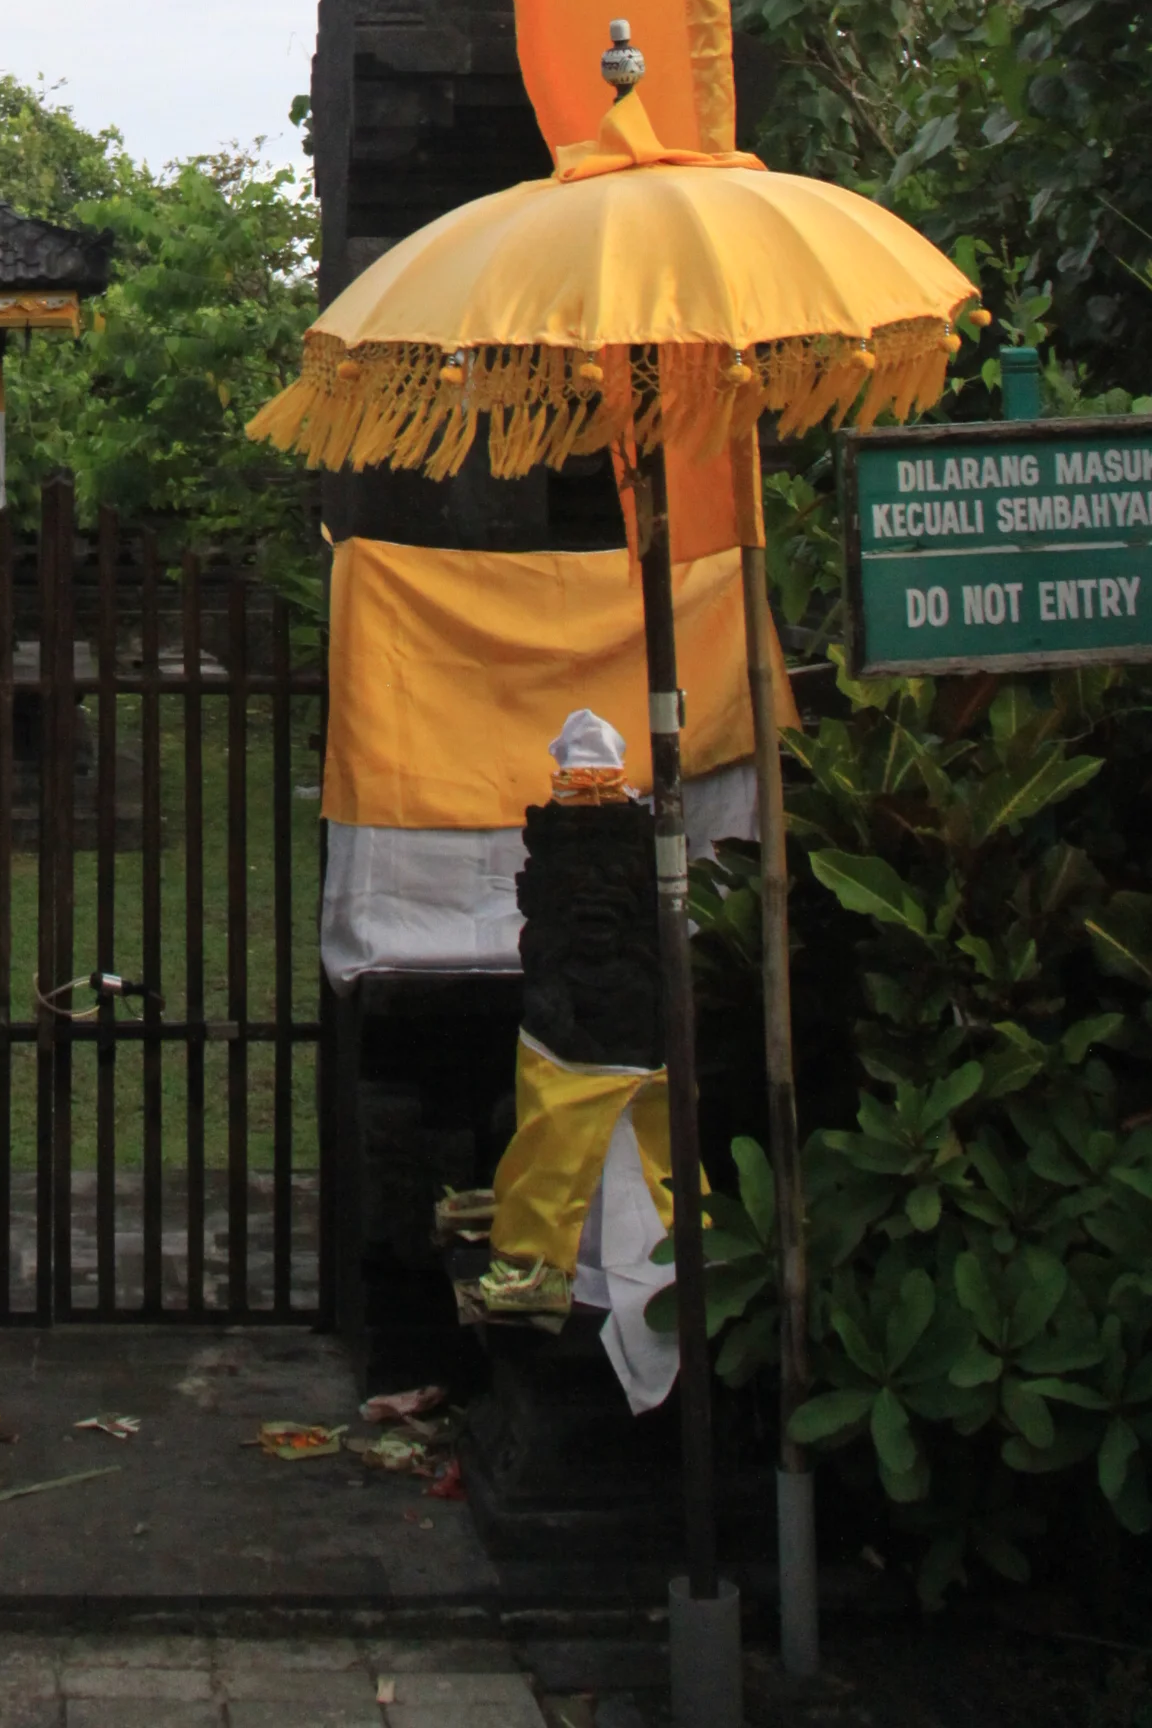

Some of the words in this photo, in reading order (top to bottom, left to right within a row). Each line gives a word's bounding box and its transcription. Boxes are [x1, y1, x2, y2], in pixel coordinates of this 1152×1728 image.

[898, 455, 1040, 492] DILARANG
[872, 500, 984, 538] KECUALI
[996, 491, 1152, 532] SEMBAHYA
[906, 586, 948, 628] DO
[963, 583, 1023, 625] NOT
[1039, 576, 1141, 621] ENTRY
